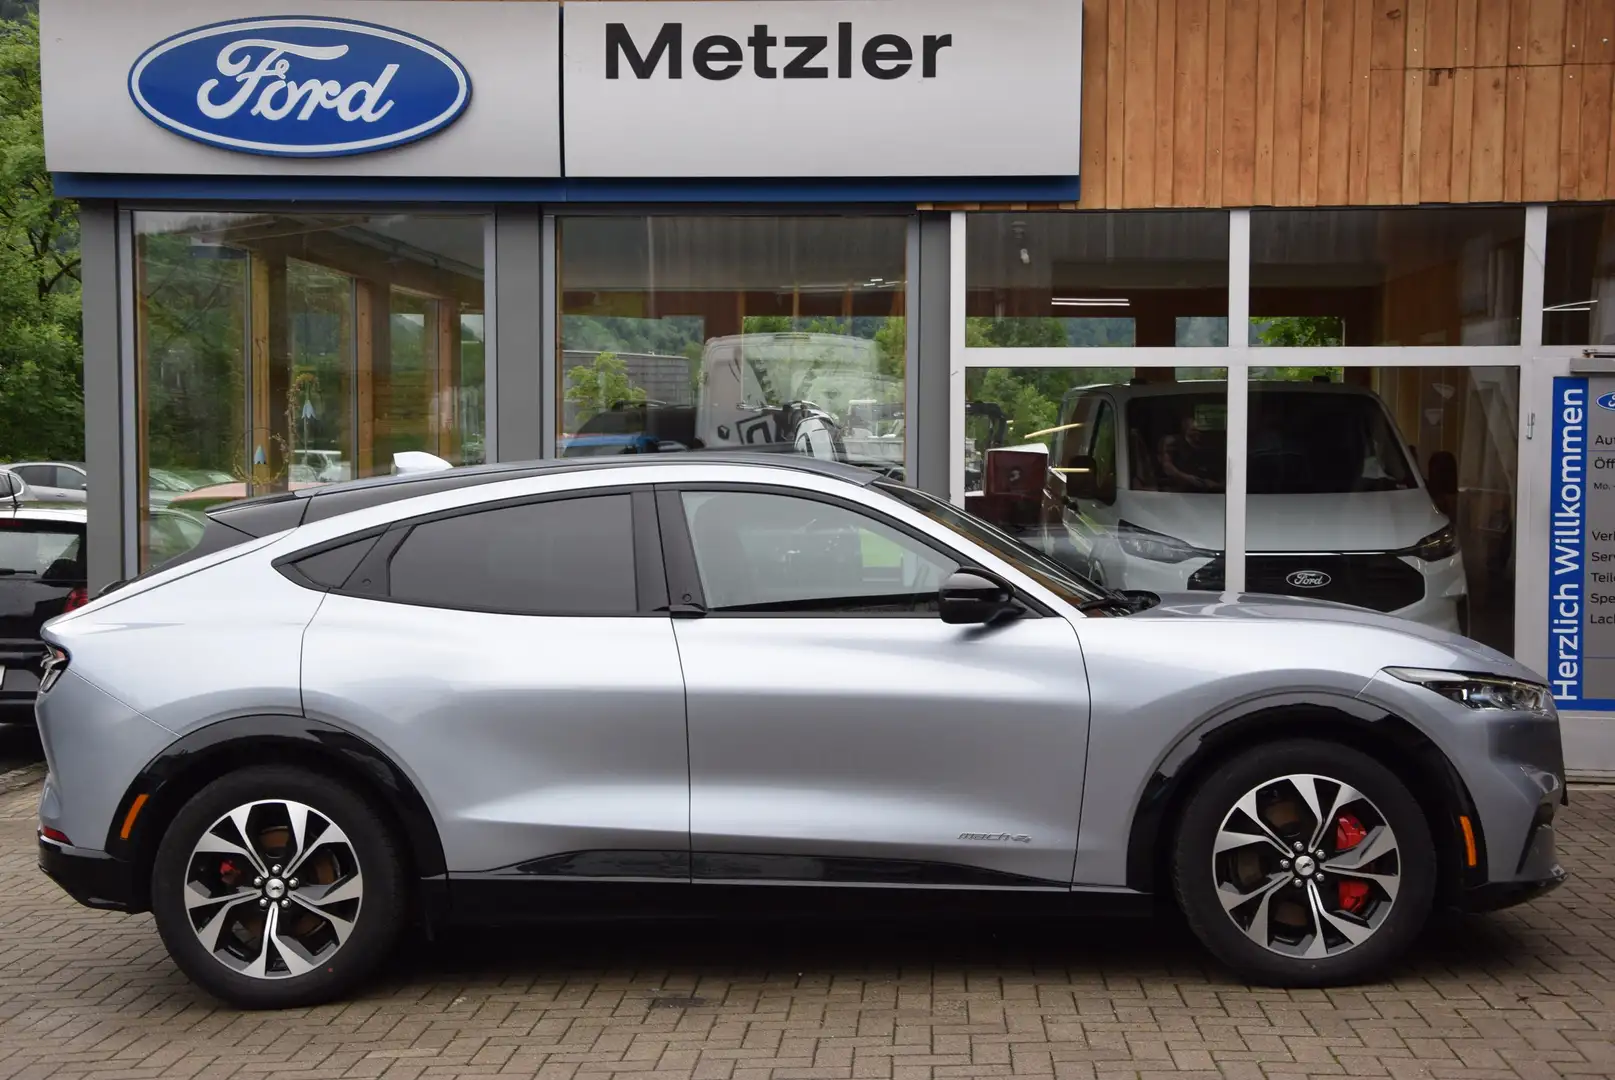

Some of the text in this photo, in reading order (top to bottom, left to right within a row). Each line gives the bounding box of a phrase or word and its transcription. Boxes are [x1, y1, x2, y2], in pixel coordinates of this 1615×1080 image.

[606, 22, 952, 81] Metzler
[197, 39, 400, 122] Ford
[1592, 530, 1615, 541] Ver
[1553, 389, 1583, 700] Herzlich Willkommen
[1294, 572, 1323, 585] Ford
[1590, 572, 1615, 583] Teil
[1590, 614, 1615, 624] Lac
